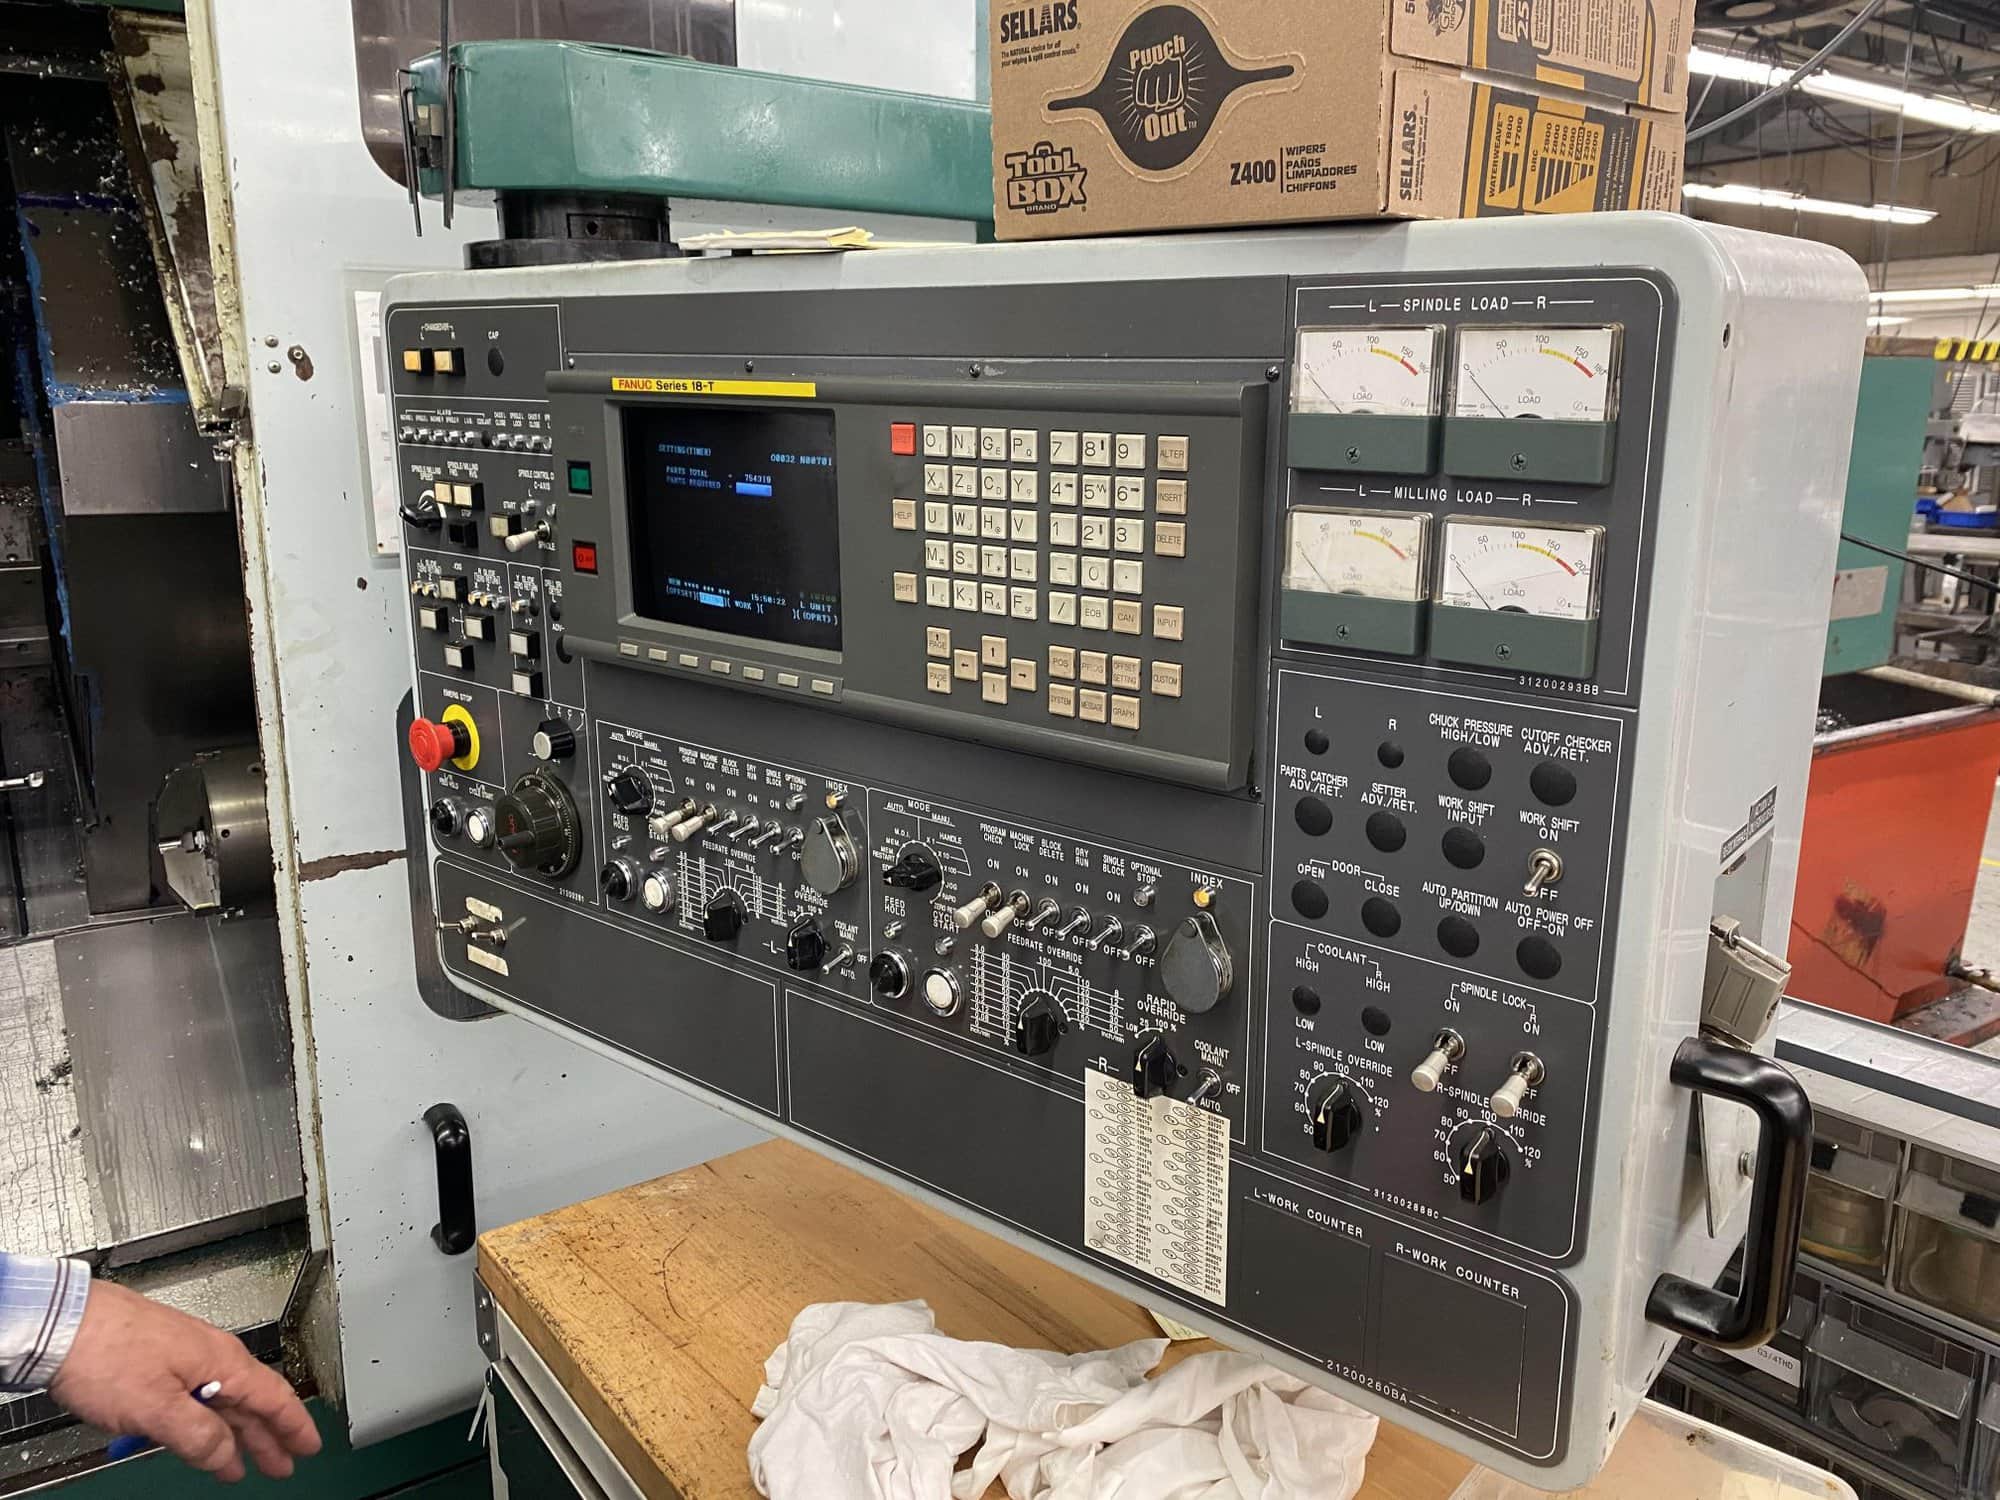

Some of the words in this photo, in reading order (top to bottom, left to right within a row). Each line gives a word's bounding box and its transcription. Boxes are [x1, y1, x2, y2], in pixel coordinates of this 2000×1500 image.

[1001, 1, 1078, 43] SELLARS
[1129, 34, 1186, 70] Punch
[1144, 108, 1187, 142] Out
[1504, 115, 1514, 147] T800
[1514, 117, 1524, 148] T700
[1543, 122, 1553, 154] Z900
[1551, 124, 1561, 155] Z800
[1559, 125, 1569, 157] Z700
[1568, 127, 1577, 158] Z600
[1583, 130, 1592, 160] Z300
[1589, 131, 1599, 161] Z200
[1286, 144, 1326, 156] WIPERS
[1400, 110, 1417, 201] SELLARS
[1006, 148, 1079, 178] TOOL
[1286, 157, 1321, 169] PAÑOS
[1488, 121, 1502, 198] WATERWEAVE
[1530, 149, 1538, 172] DRC
[1230, 160, 1276, 185] Z400
[1286, 165, 1358, 180] LIMPIADORES
[1009, 170, 1086, 208] BOX
[1286, 180, 1336, 193] CHIFFONS
[1026, 204, 1057, 213] BRAND
[1404, 297, 1461, 311] SPINDLE
[1472, 296, 1508, 310] LOAD
[487, 330, 499, 340] CAP
[1496, 339, 1507, 350] 50
[1535, 334, 1550, 344] 100
[1574, 345, 1589, 359] 150
[618, 379, 653, 390] FANUC
[655, 380, 688, 391] Series
[691, 380, 715, 392] 18-T
[1352, 392, 1373, 401] LOAD
[1518, 395, 1541, 404] LOAD
[1160, 450, 1184, 460] ALTER
[1158, 493, 1183, 503] INSERT
[1394, 486, 1447, 502] MILLING
[1457, 490, 1493, 504] LOAD
[1157, 535, 1182, 546] DELETE
[1477, 535, 1489, 545] 50
[1511, 531, 1526, 540] 100
[1546, 538, 1560, 551] 150
[1504, 588, 1525, 597] LOAD
[1085, 608, 1101, 618] EOB
[1117, 613, 1134, 623] CAN
[1157, 617, 1177, 628] INPUT
[1429, 713, 1459, 729] CHUCK
[1464, 718, 1513, 738] PRESSURE
[1440, 727, 1501, 747] HIGH/LOW
[1521, 728, 1560, 744] CUTOFF
[1565, 735, 1612, 753] CHECKER
[1524, 742, 1590, 763] ADV./RET.
[1280, 764, 1307, 779] PARTS
[1310, 770, 1348, 788] CATCHER
[825, 780, 848, 794] INDEX
[1289, 779, 1343, 798] ADV./RET.
[1372, 782, 1407, 798] SETTER
[907, 799, 931, 812] MODE
[1360, 792, 1418, 814] ADV./RET.
[1438, 795, 1463, 810] WORK
[1468, 800, 1495, 816] SHIFT
[1447, 810, 1484, 826] INPUT
[1519, 810, 1546, 826] WORK
[1551, 817, 1580, 833] SHIFT
[939, 832, 963, 845] HANDLE
[980, 823, 1007, 838] PROGRAM
[1010, 831, 1035, 845] MACHINE
[1539, 828, 1559, 842] ON
[983, 833, 1003, 845] CHECK
[1014, 841, 1030, 852] LOCK
[1041, 838, 1062, 851] BLOCK
[1039, 847, 1064, 862] DELETE
[1075, 847, 1089, 858] DRY
[1075, 856, 1089, 868] RUN
[1102, 854, 1125, 868] SINGLE
[1332, 860, 1361, 876] DOOR
[1102, 864, 1125, 878] BLOCK
[1130, 862, 1162, 878] OPTIONAL
[1297, 863, 1325, 879] OPEN
[1137, 873, 1156, 885] STOP
[1190, 872, 1224, 889] INDEX
[1364, 879, 1400, 897] CLOSE
[1422, 881, 1447, 897] AUTO
[1451, 887, 1499, 909] PARTITION
[885, 896, 906, 909] FEED
[1439, 897, 1481, 917] UP/DOWN
[885, 905, 906, 917] HOLD
[1505, 901, 1531, 917] AUTO
[1536, 907, 1568, 926] POWER
[1574, 917, 1594, 931] OFF
[834, 920, 859, 935] COOLANT
[933, 920, 960, 934] START
[1517, 916, 1565, 937] OFF-ON
[1007, 933, 1043, 953] FEEDRATE
[1047, 945, 1083, 965] OVERRIDE
[1317, 943, 1367, 965] COOLANT
[1135, 954, 1155, 968] OFF
[1295, 957, 1319, 973] HIGH
[1365, 977, 1391, 993] HIGH
[1146, 994, 1177, 1012] RAPID
[1460, 981, 1498, 1001] SPINDLE
[1502, 993, 1527, 1010] LOCK
[1137, 1000, 1186, 1025] OVERRIDE
[1444, 999, 1460, 1013] ON
[1295, 1016, 1315, 1031] LOW
[1523, 1021, 1540, 1036] ON
[1194, 1039, 1230, 1060] COOLANT
[1364, 1037, 1385, 1054] LOW
[1099, 1057, 1107, 1072] R
[1295, 1036, 1343, 1061] L-SPINDLE
[1348, 1054, 1393, 1078] OVERRIDE
[1226, 1082, 1241, 1095] OFF
[1334, 1062, 1350, 1075] 100
[1360, 1076, 1375, 1089] 110
[1374, 1097, 1389, 1109] 120
[1436, 1083, 1489, 1108] R-SPINDLE
[1481, 1109, 1497, 1122] 100
[1509, 1124, 1525, 1138] 110
[1524, 1146, 1541, 1160] 120
[1254, 1187, 1299, 1214] L-WORK
[1306, 1208, 1364, 1239] COUNTER
[1395, 1242, 1447, 1272] R-WORK
[1455, 1265, 1521, 1299] COUNTER
